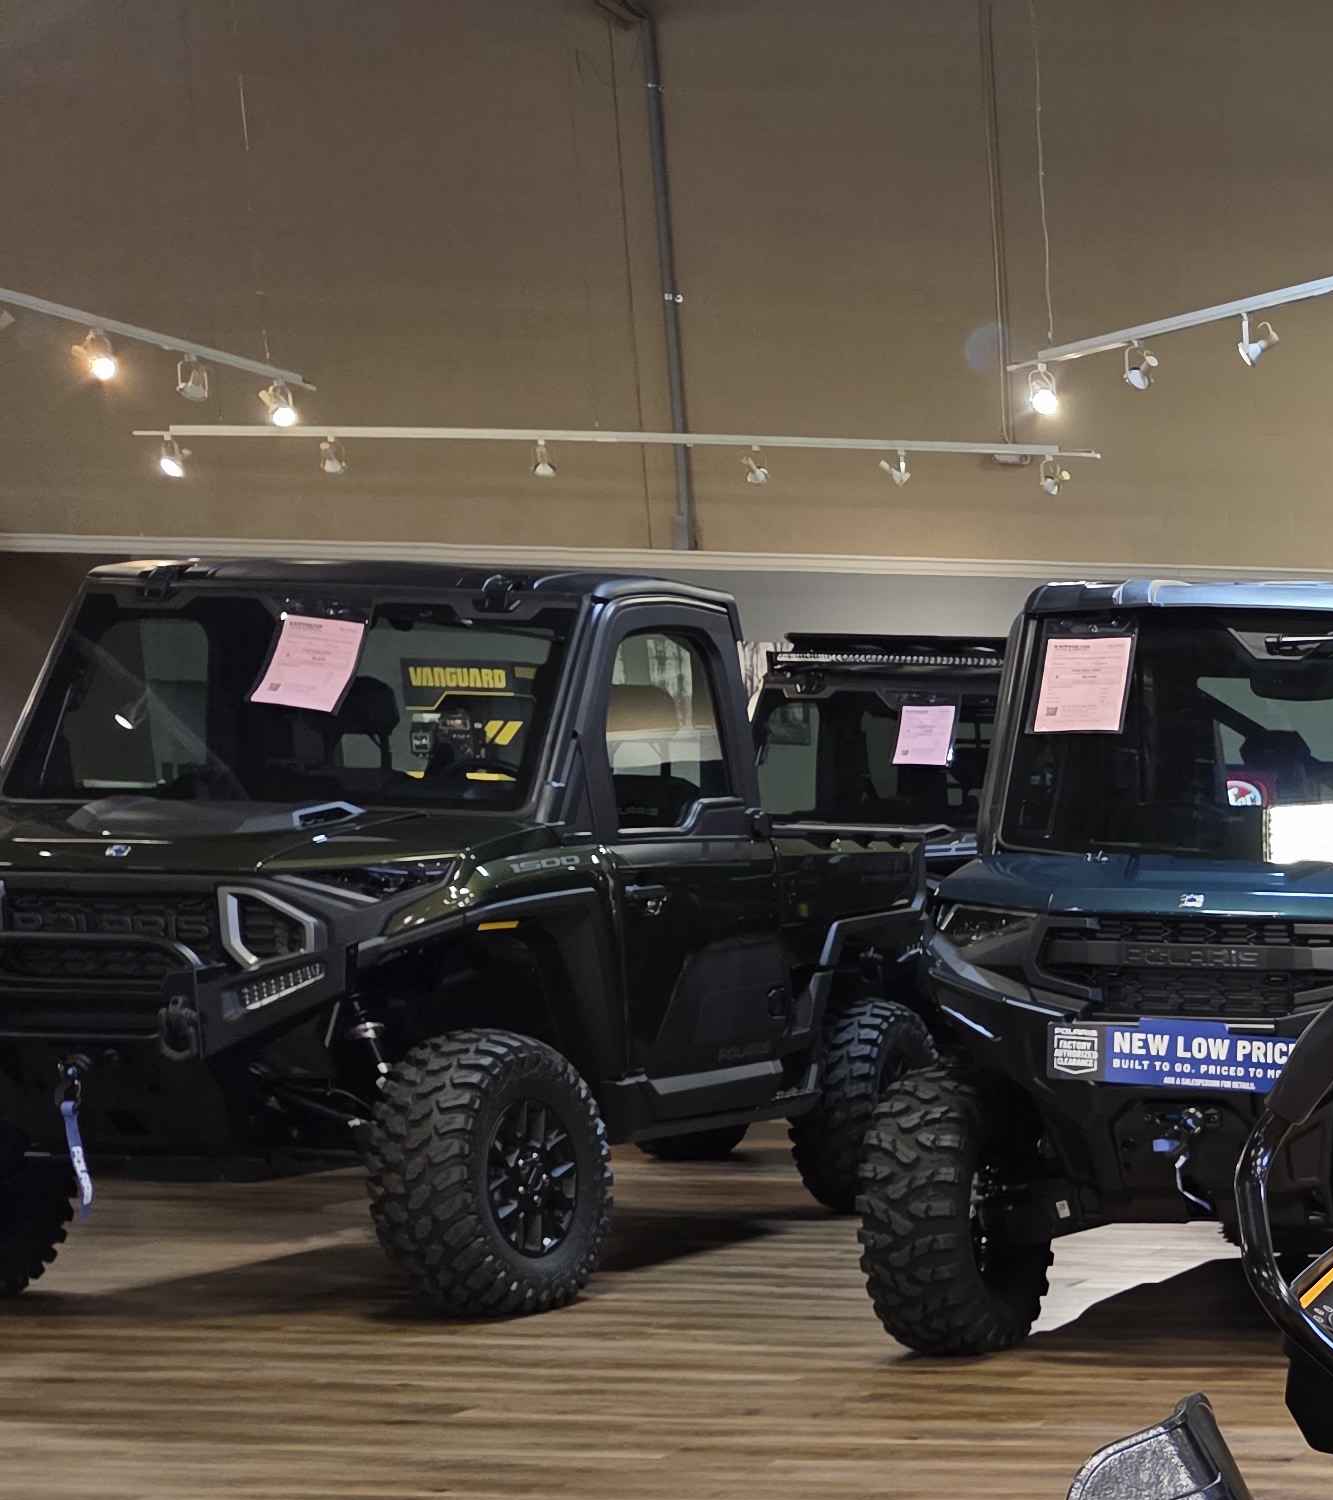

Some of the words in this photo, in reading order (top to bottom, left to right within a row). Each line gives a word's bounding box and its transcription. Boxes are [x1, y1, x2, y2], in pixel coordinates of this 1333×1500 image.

[408, 666, 507, 688] VANGUARD
[510, 855, 580, 873] 1500
[1113, 1031, 1170, 1056] NEW
[1177, 1035, 1230, 1061] LOW
[1112, 1058, 1150, 1071] BUILT
[1154, 1061, 1170, 1073] TO
[1200, 1064, 1245, 1077] PRICED
[1248, 1067, 1264, 1078] TO
